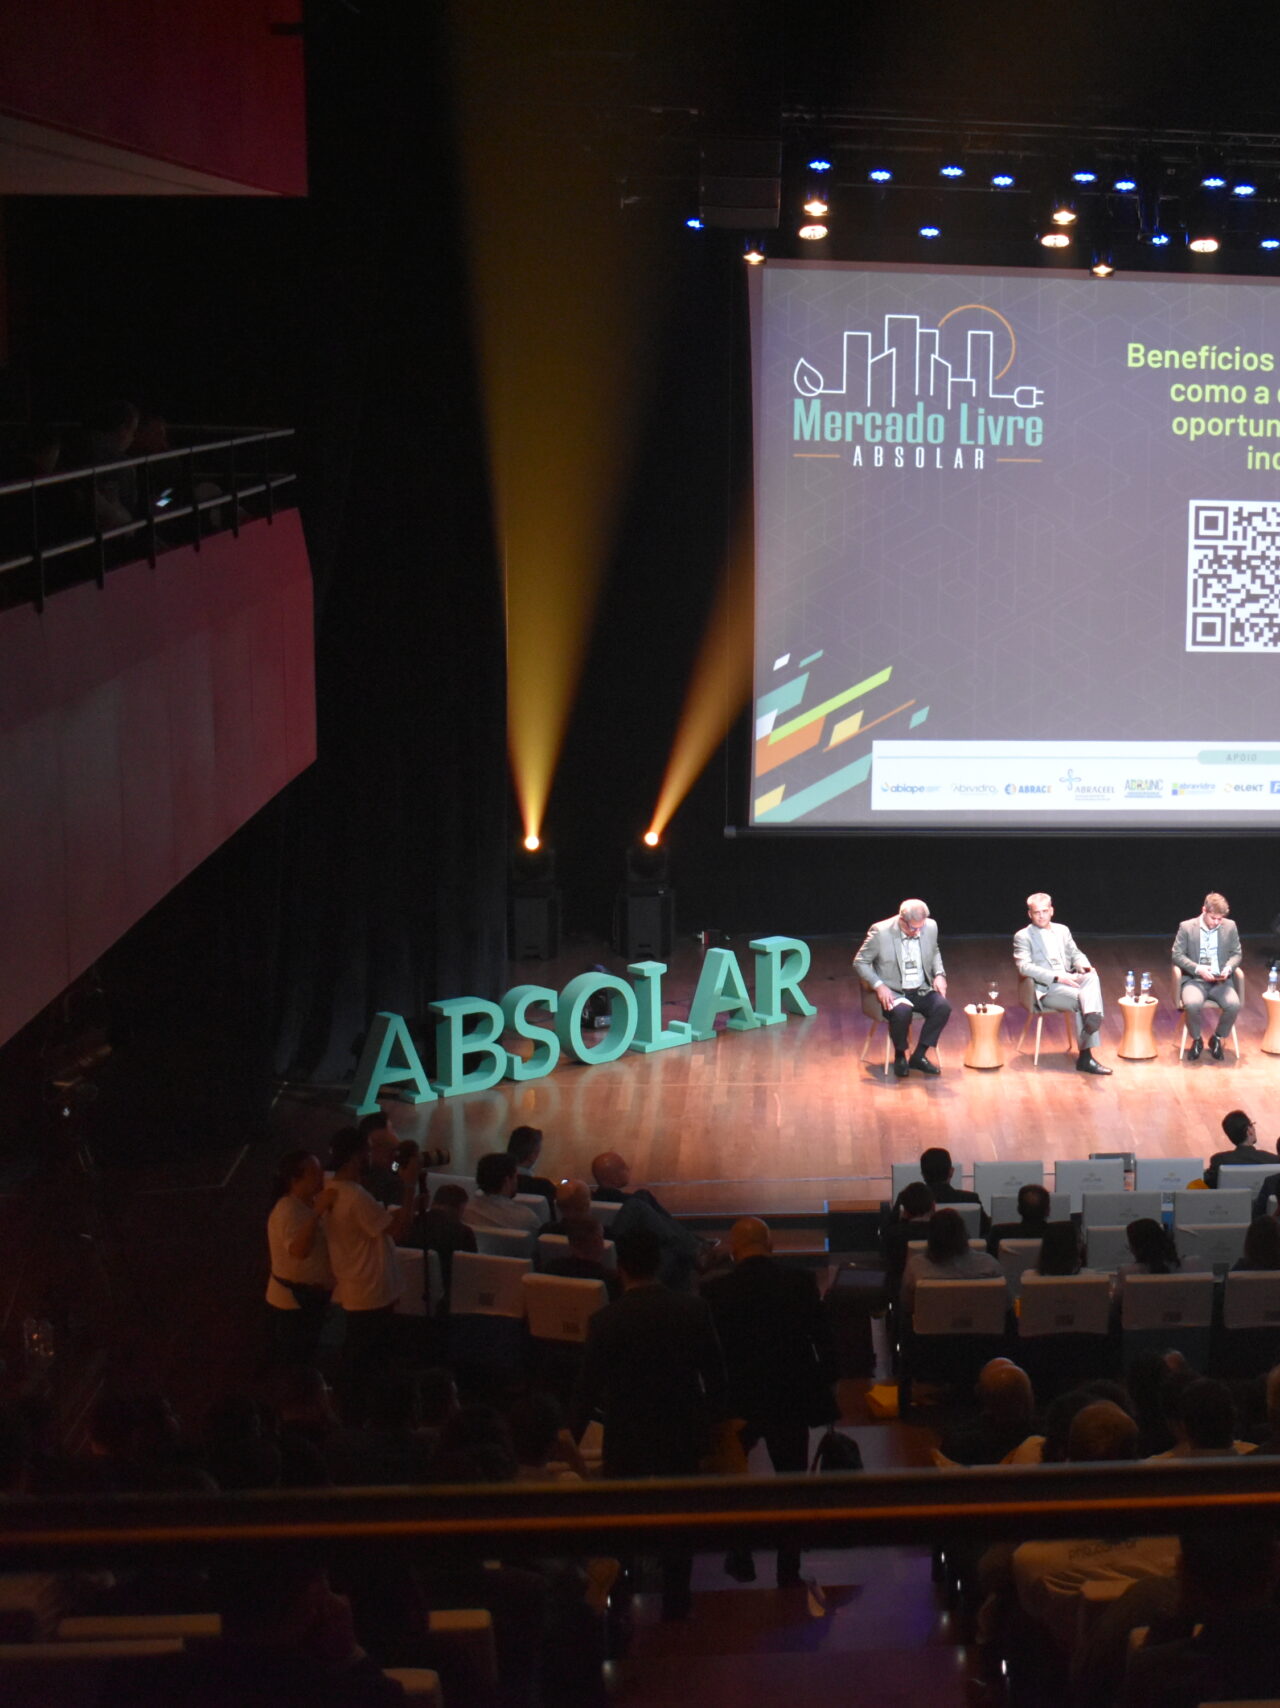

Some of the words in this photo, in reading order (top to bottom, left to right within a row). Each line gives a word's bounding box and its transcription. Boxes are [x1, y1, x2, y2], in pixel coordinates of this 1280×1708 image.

[1127, 342, 1275, 372] Benefícios
[1169, 383, 1248, 404] como
[1253, 385, 1270, 405] a
[793, 397, 945, 444] Mercado
[959, 402, 1044, 446] Livre
[853, 445, 985, 469] ABSOLAR
[1225, 753, 1257, 762] APOIO
[348, 935, 817, 1116] ABSOLAR
